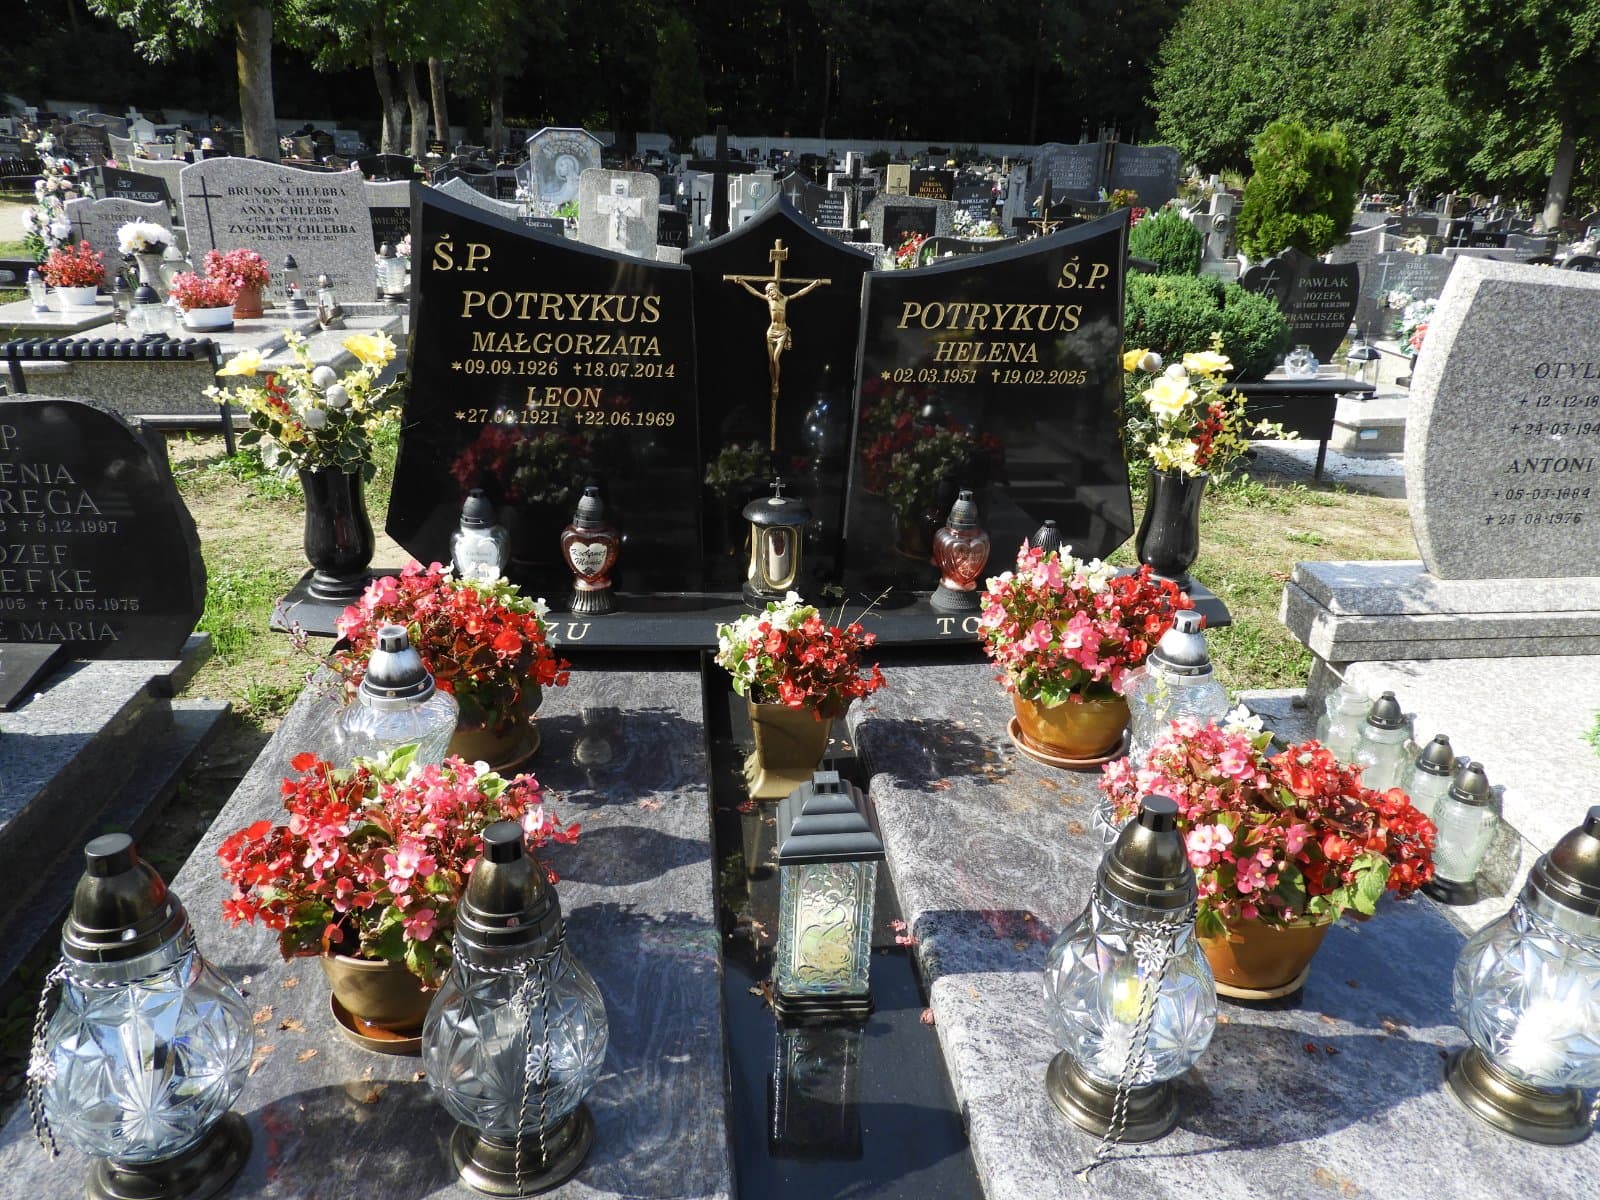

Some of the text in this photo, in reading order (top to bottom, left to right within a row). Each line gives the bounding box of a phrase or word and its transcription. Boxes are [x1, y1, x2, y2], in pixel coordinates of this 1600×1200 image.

[228, 187, 346, 197] BRUNON CHLEBBA
[240, 206, 339, 215] ANNA CHLEBBA
[228, 224, 357, 234] ZYGMUNT CHLEBBA
[432, 233, 491, 272] Ś.P.
[1057, 255, 1109, 290] Ś.P.
[1298, 278, 1349, 288] PAWLAK
[461, 290, 661, 323] POTRYKUS
[897, 301, 1083, 332] POTRYKUS
[1285, 312, 1345, 320] FRANCISZEK
[471, 331, 662, 356] MAŁGORZATA
[932, 341, 1039, 363] HELENA
[1535, 362, 1600, 379] OTYL
[526, 386, 603, 408] LEON
[0, 464, 76, 484] ENIA
[1504, 457, 1595, 474] ANTONI
[0, 488, 102, 518] RĘGA
[0, 569, 97, 592] EFKE
[20, 621, 119, 641] MARIA
[936, 616, 980, 635] TO
